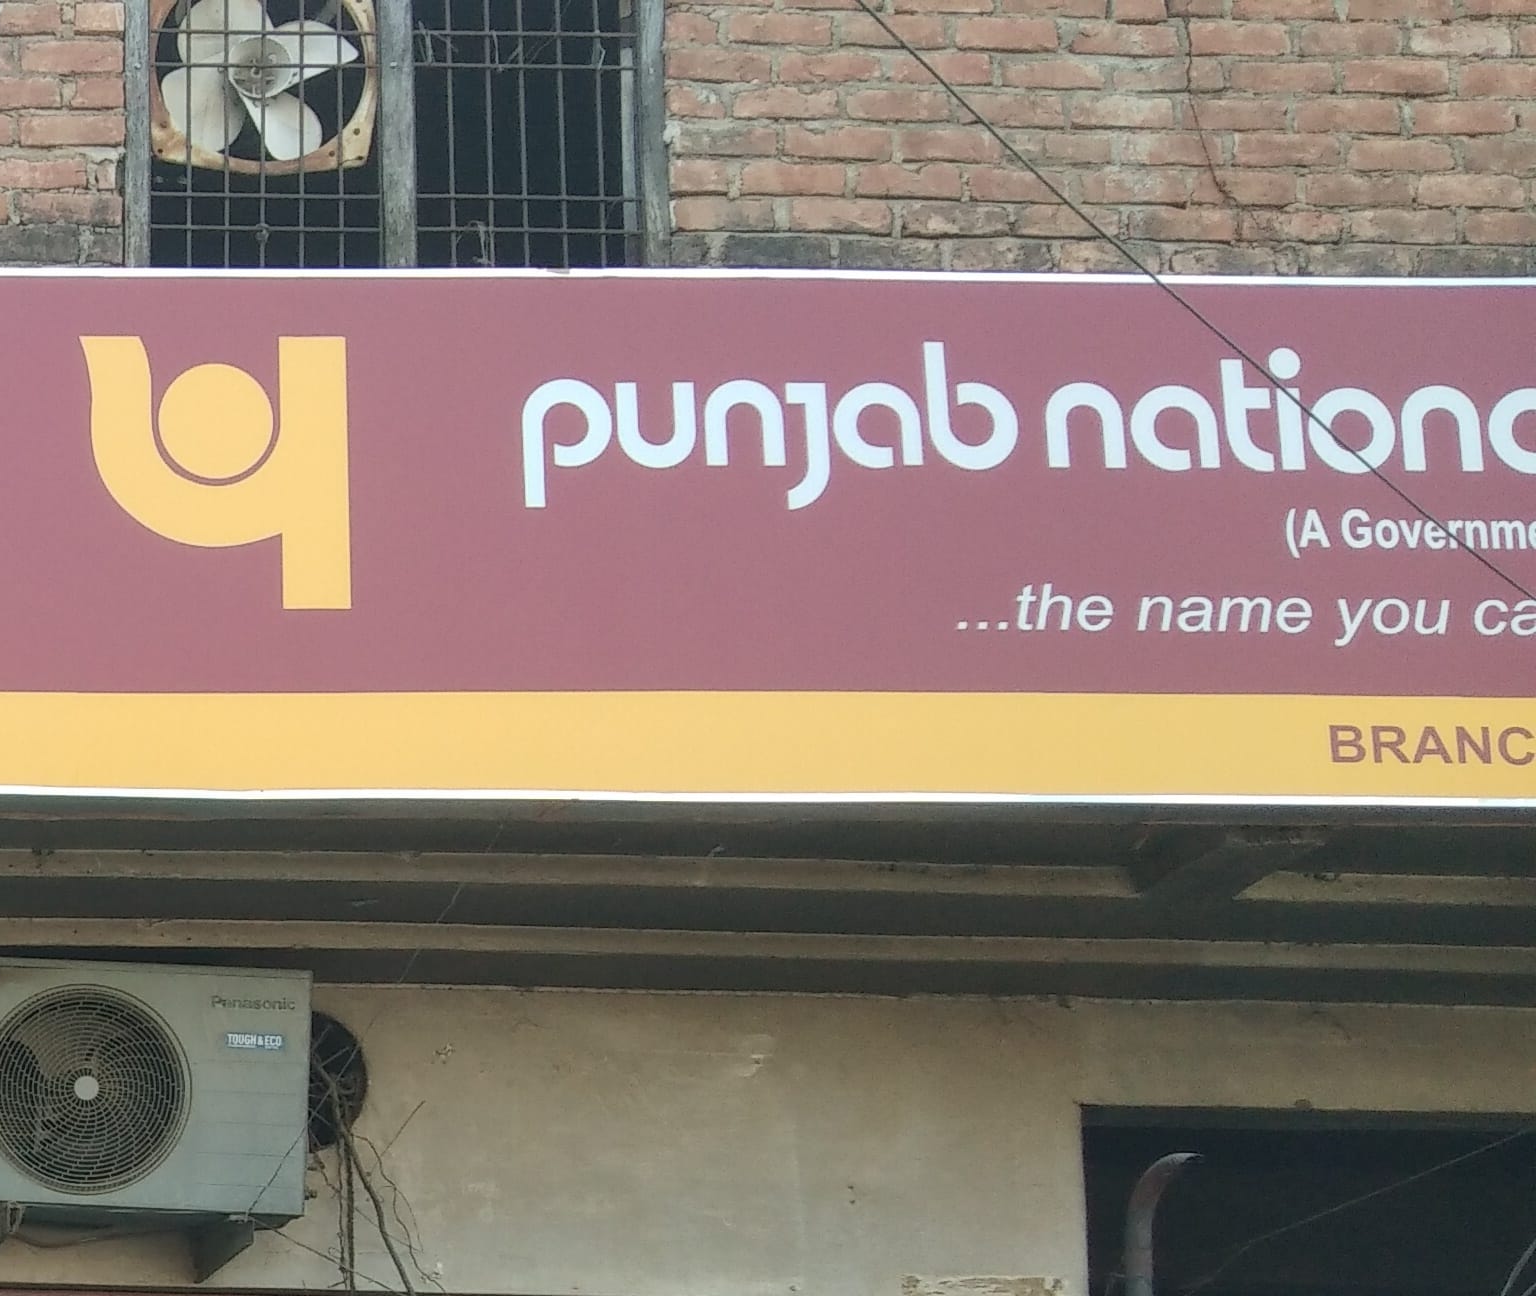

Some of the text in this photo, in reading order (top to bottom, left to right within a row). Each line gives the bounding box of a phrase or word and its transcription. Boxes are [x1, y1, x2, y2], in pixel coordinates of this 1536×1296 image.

[521, 340, 1020, 512] punjab
[1285, 508, 1331, 559] (A
[1136, 595, 1451, 647] name you
[211, 995, 296, 1011] Panasonic
